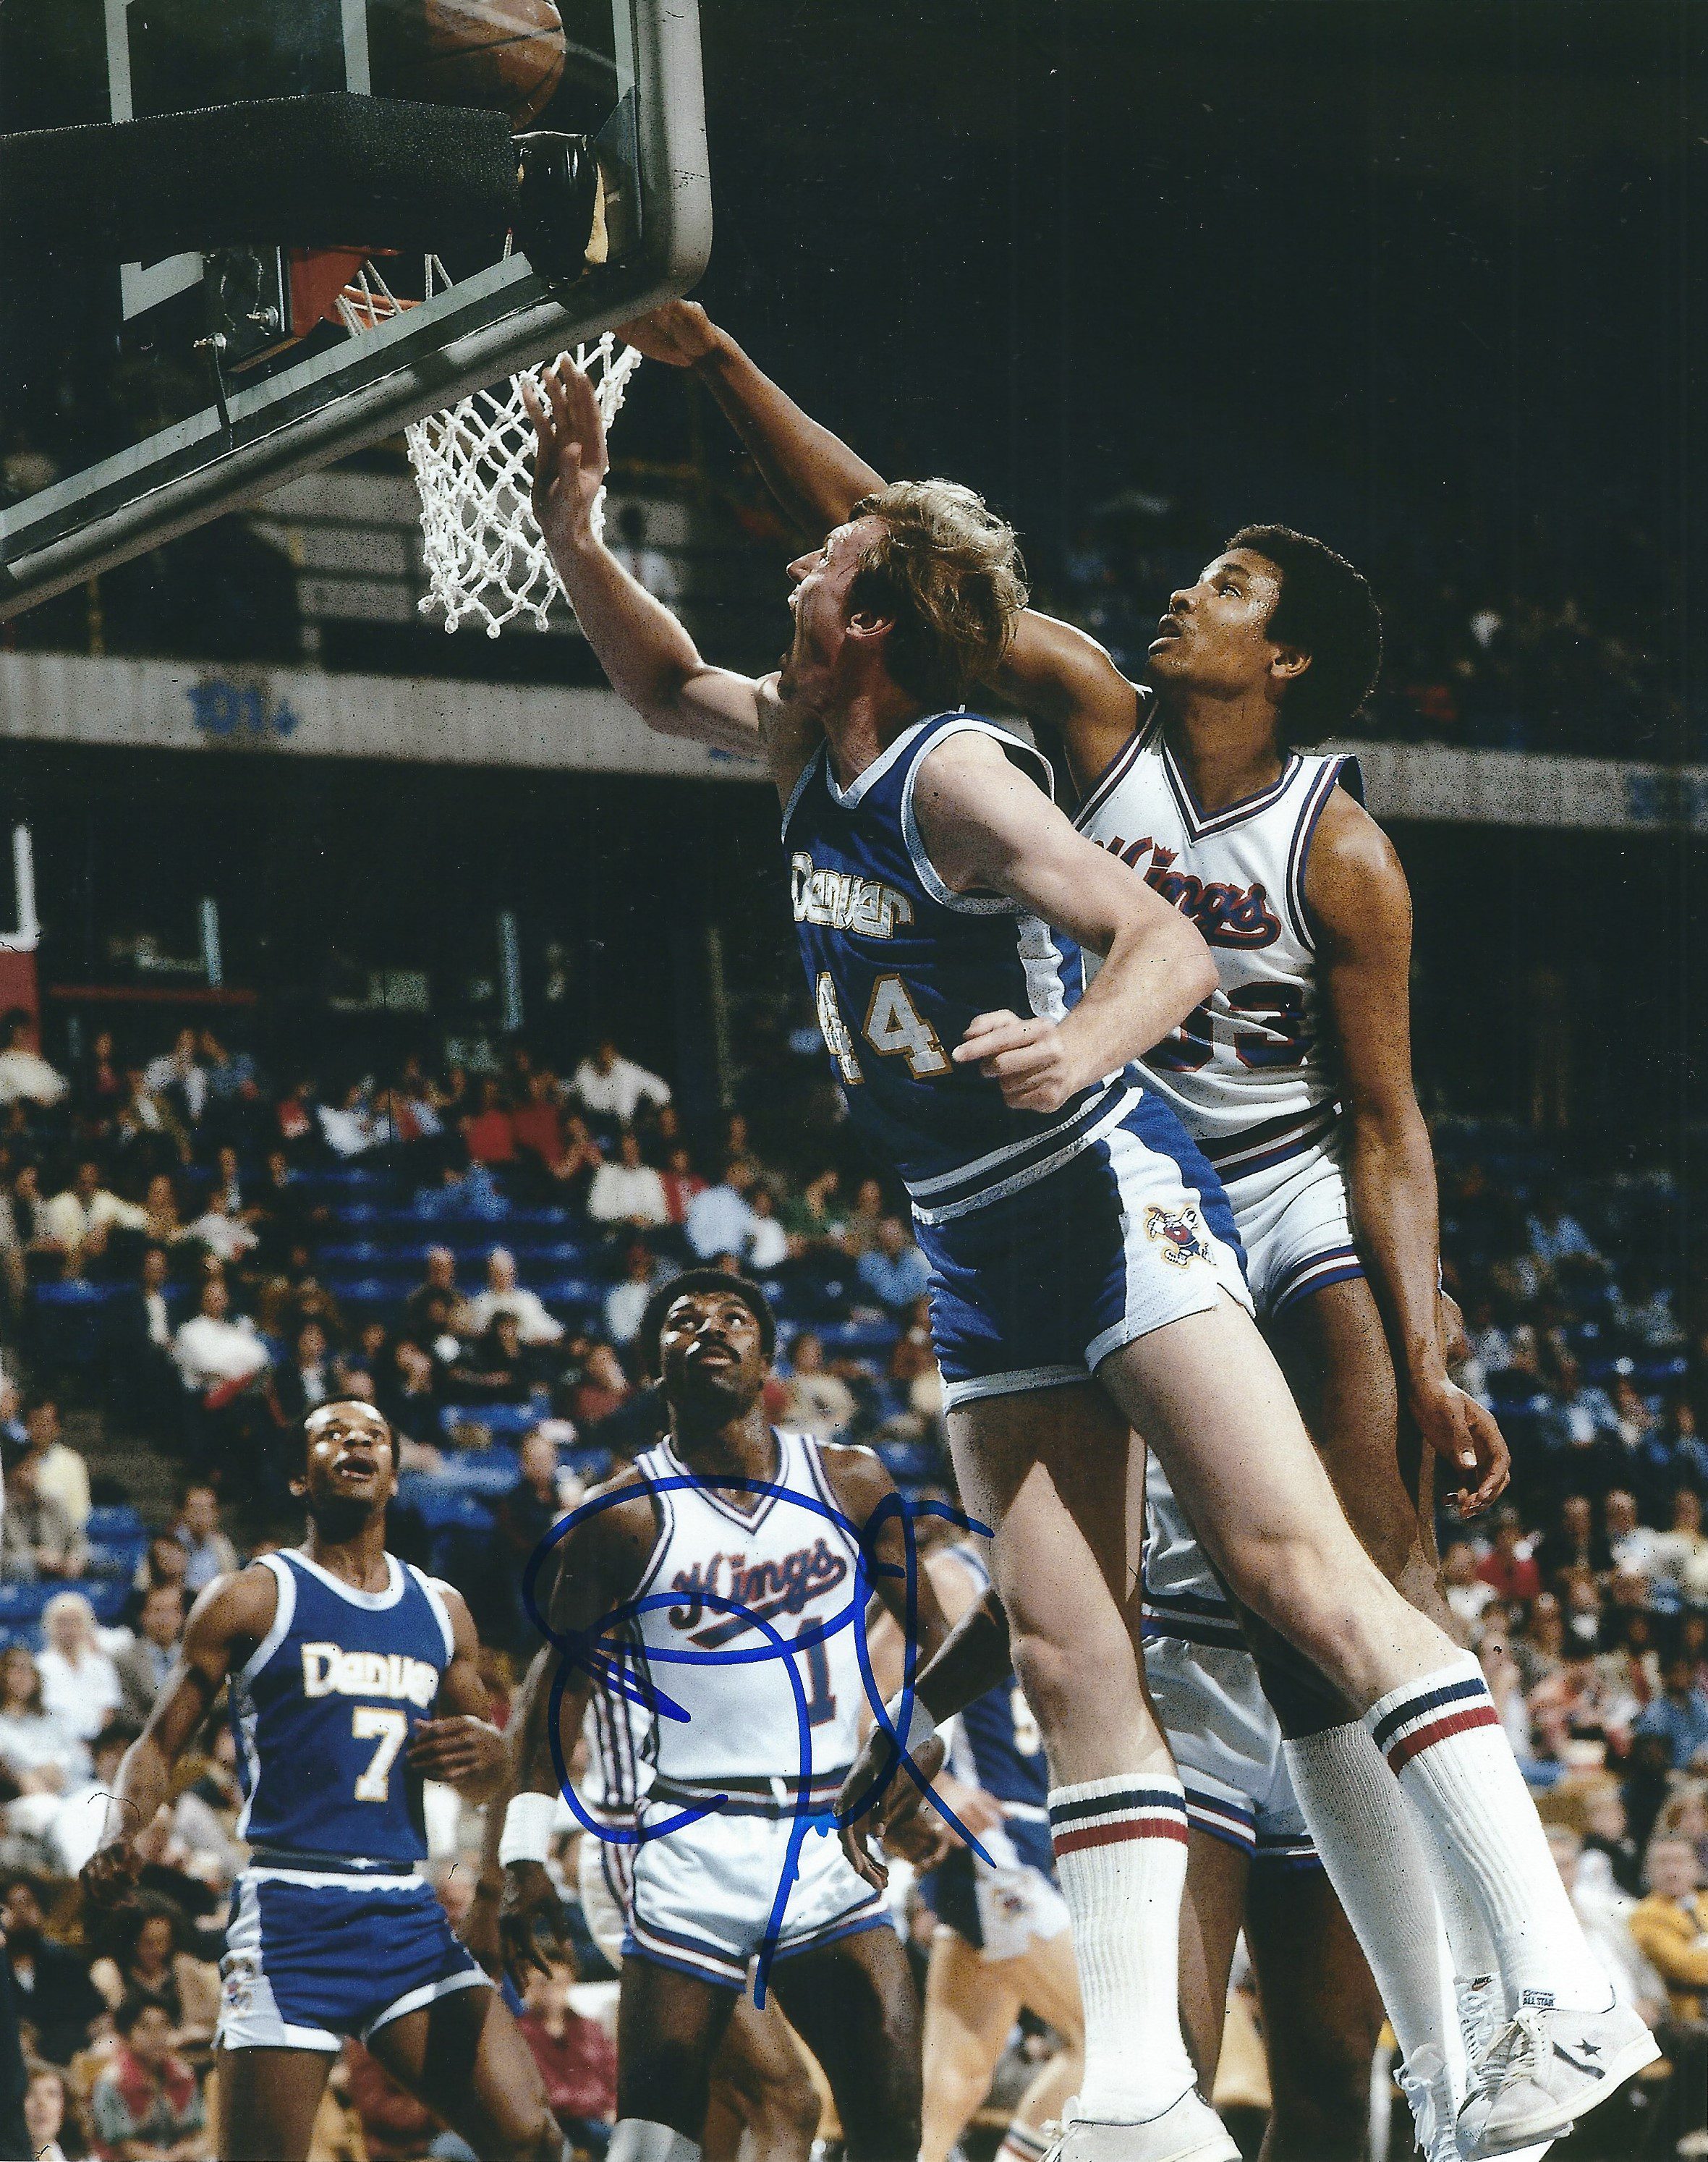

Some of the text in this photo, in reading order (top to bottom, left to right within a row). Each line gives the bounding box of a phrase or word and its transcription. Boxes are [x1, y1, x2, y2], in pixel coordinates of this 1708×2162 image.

[791, 852, 914, 939] Denver
[815, 972, 953, 1083] 44
[669, 1538, 847, 1650] Kings
[796, 1616, 836, 1727] 1
[351, 1704, 409, 1803] 7
[1473, 1975, 1492, 1985] NIKE
[1522, 1997, 1555, 2007] ALL STAR
